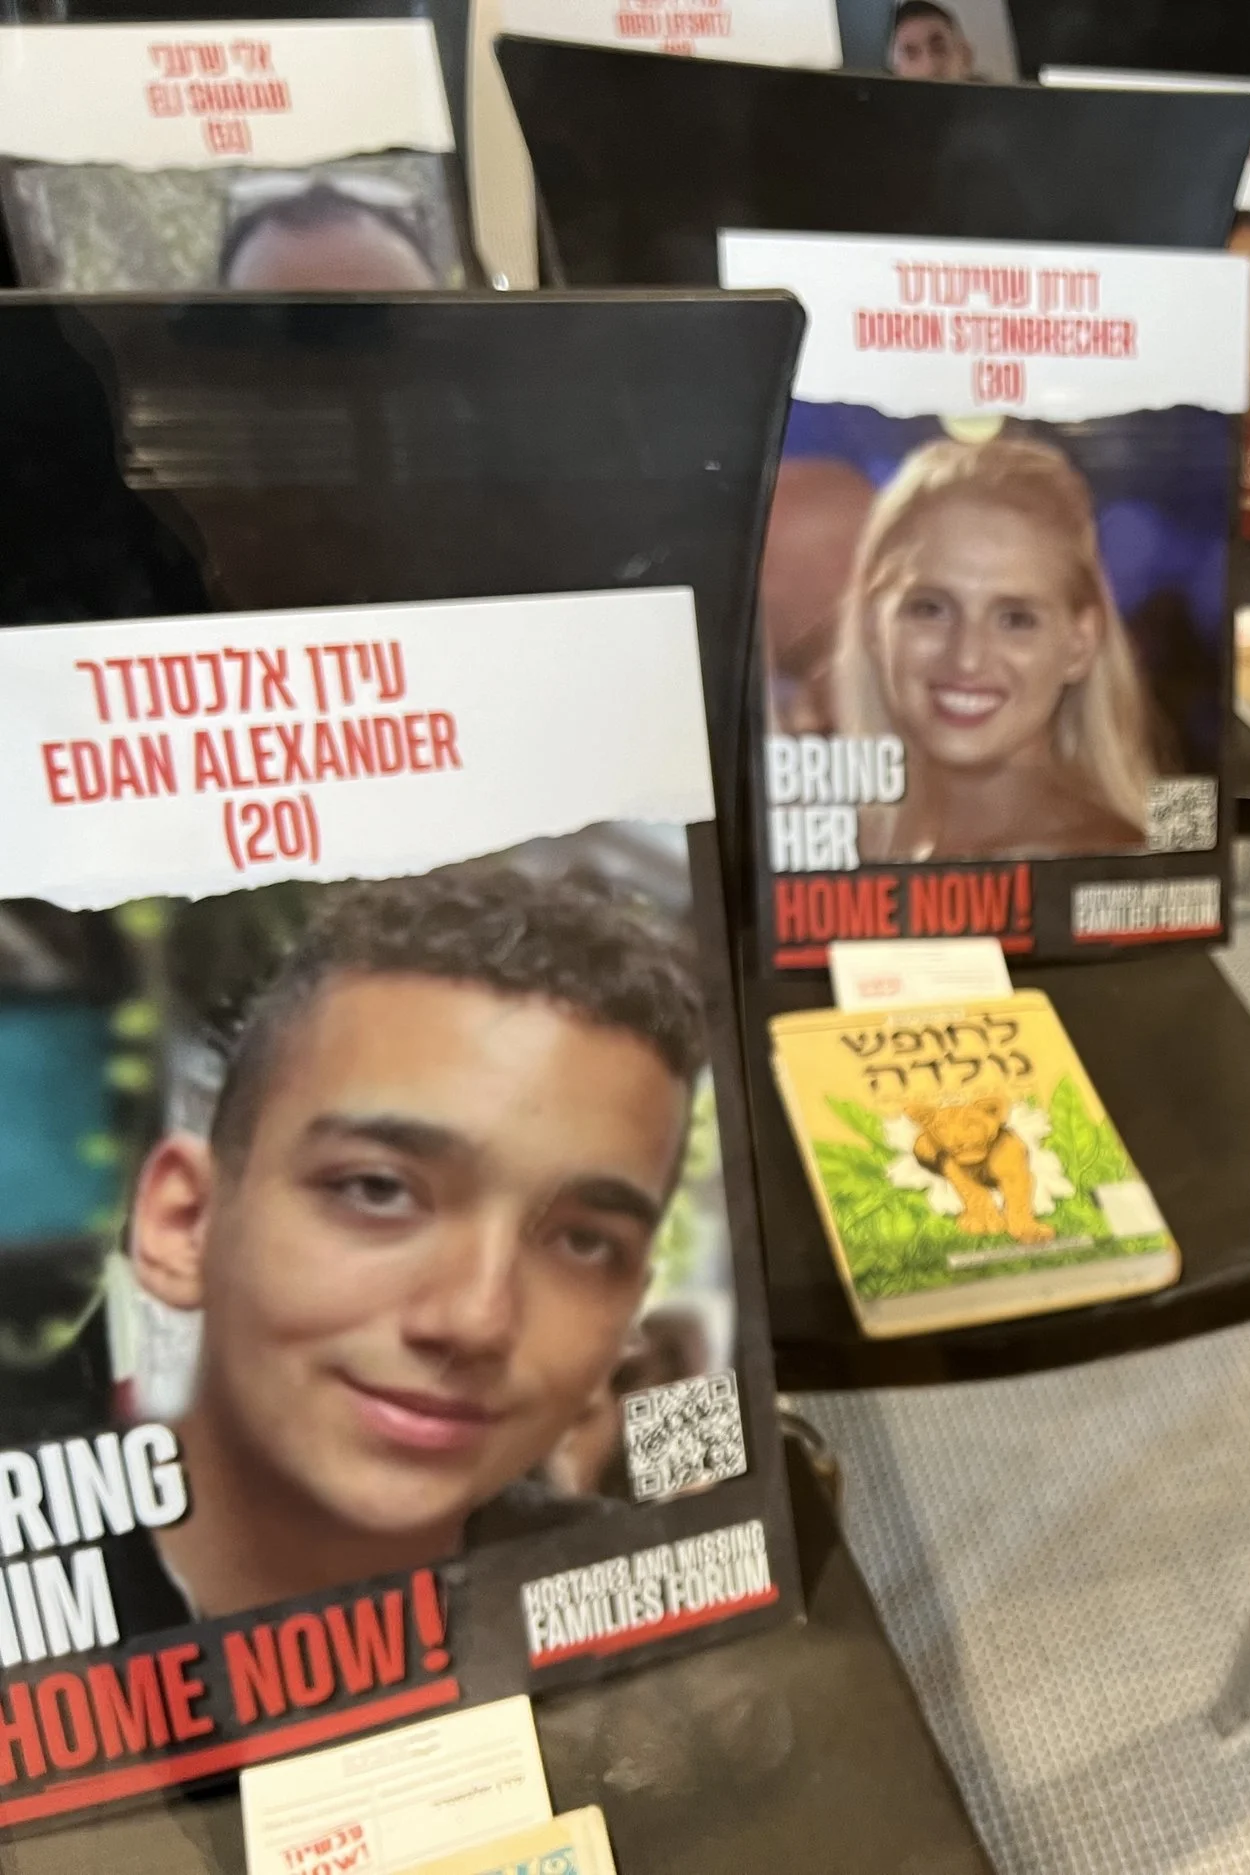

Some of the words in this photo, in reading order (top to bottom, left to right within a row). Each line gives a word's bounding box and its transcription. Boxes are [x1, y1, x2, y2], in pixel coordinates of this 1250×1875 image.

[855, 310, 944, 351] DORON
[951, 313, 1138, 359] STEINBRECHER
[75, 645, 294, 723] אלכסנדר
[304, 639, 407, 715] עידן
[41, 732, 177, 805] EDAN
[194, 708, 463, 794] ALEXANDER
[766, 733, 906, 804] BRING
[223, 792, 322, 872] (20)
[769, 804, 860, 873] HER
[774, 876, 899, 943] HOME
[910, 861, 1031, 936] NOW!
[840, 1012, 1019, 1057] לחופש
[863, 1049, 1033, 1093] נולדה
[631, 1544, 677, 1584] AND
[674, 1519, 767, 1569] MISSING
[527, 1577, 665, 1656] FAMILIES
[663, 1549, 771, 1618] FORUM
[0, 1643, 214, 1785] HOME
[223, 1568, 449, 1725] NOW!
